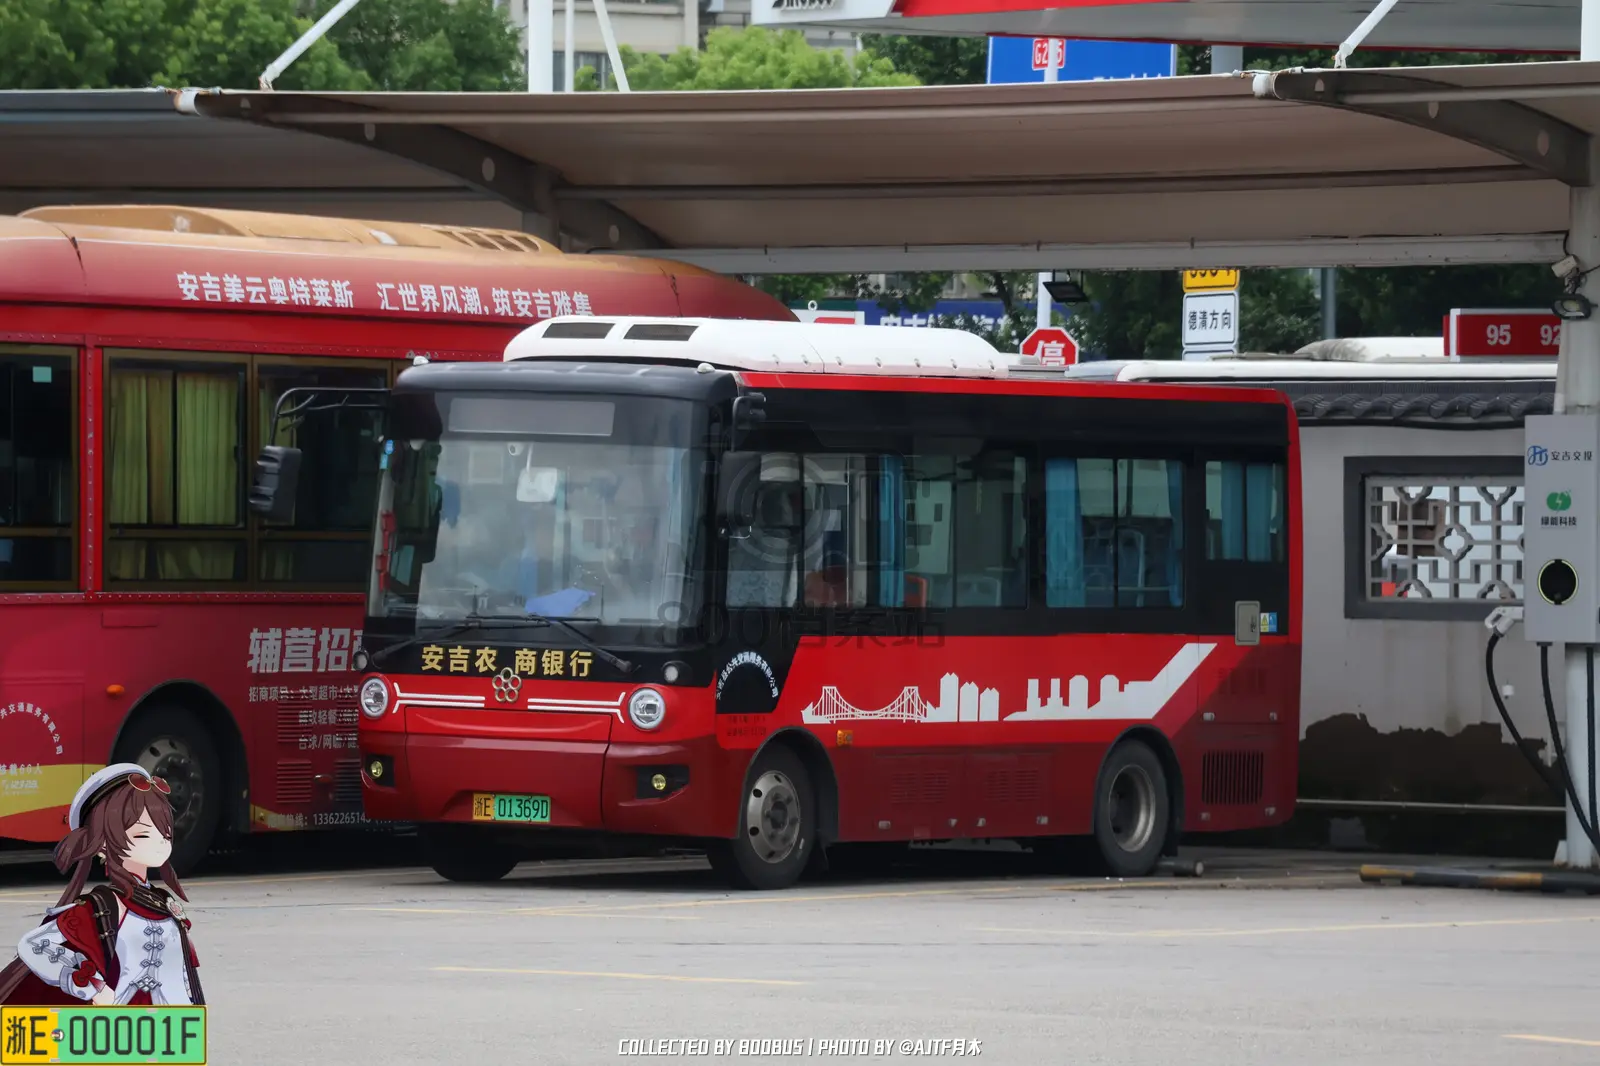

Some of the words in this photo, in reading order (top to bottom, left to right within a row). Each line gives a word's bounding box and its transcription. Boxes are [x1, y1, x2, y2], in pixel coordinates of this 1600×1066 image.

[1035, 42, 1063, 65] G25
[176, 271, 354, 308] 安吉美云奥特莱斯
[1188, 309, 1232, 331] 德清方向
[1486, 324, 1512, 346] 95
